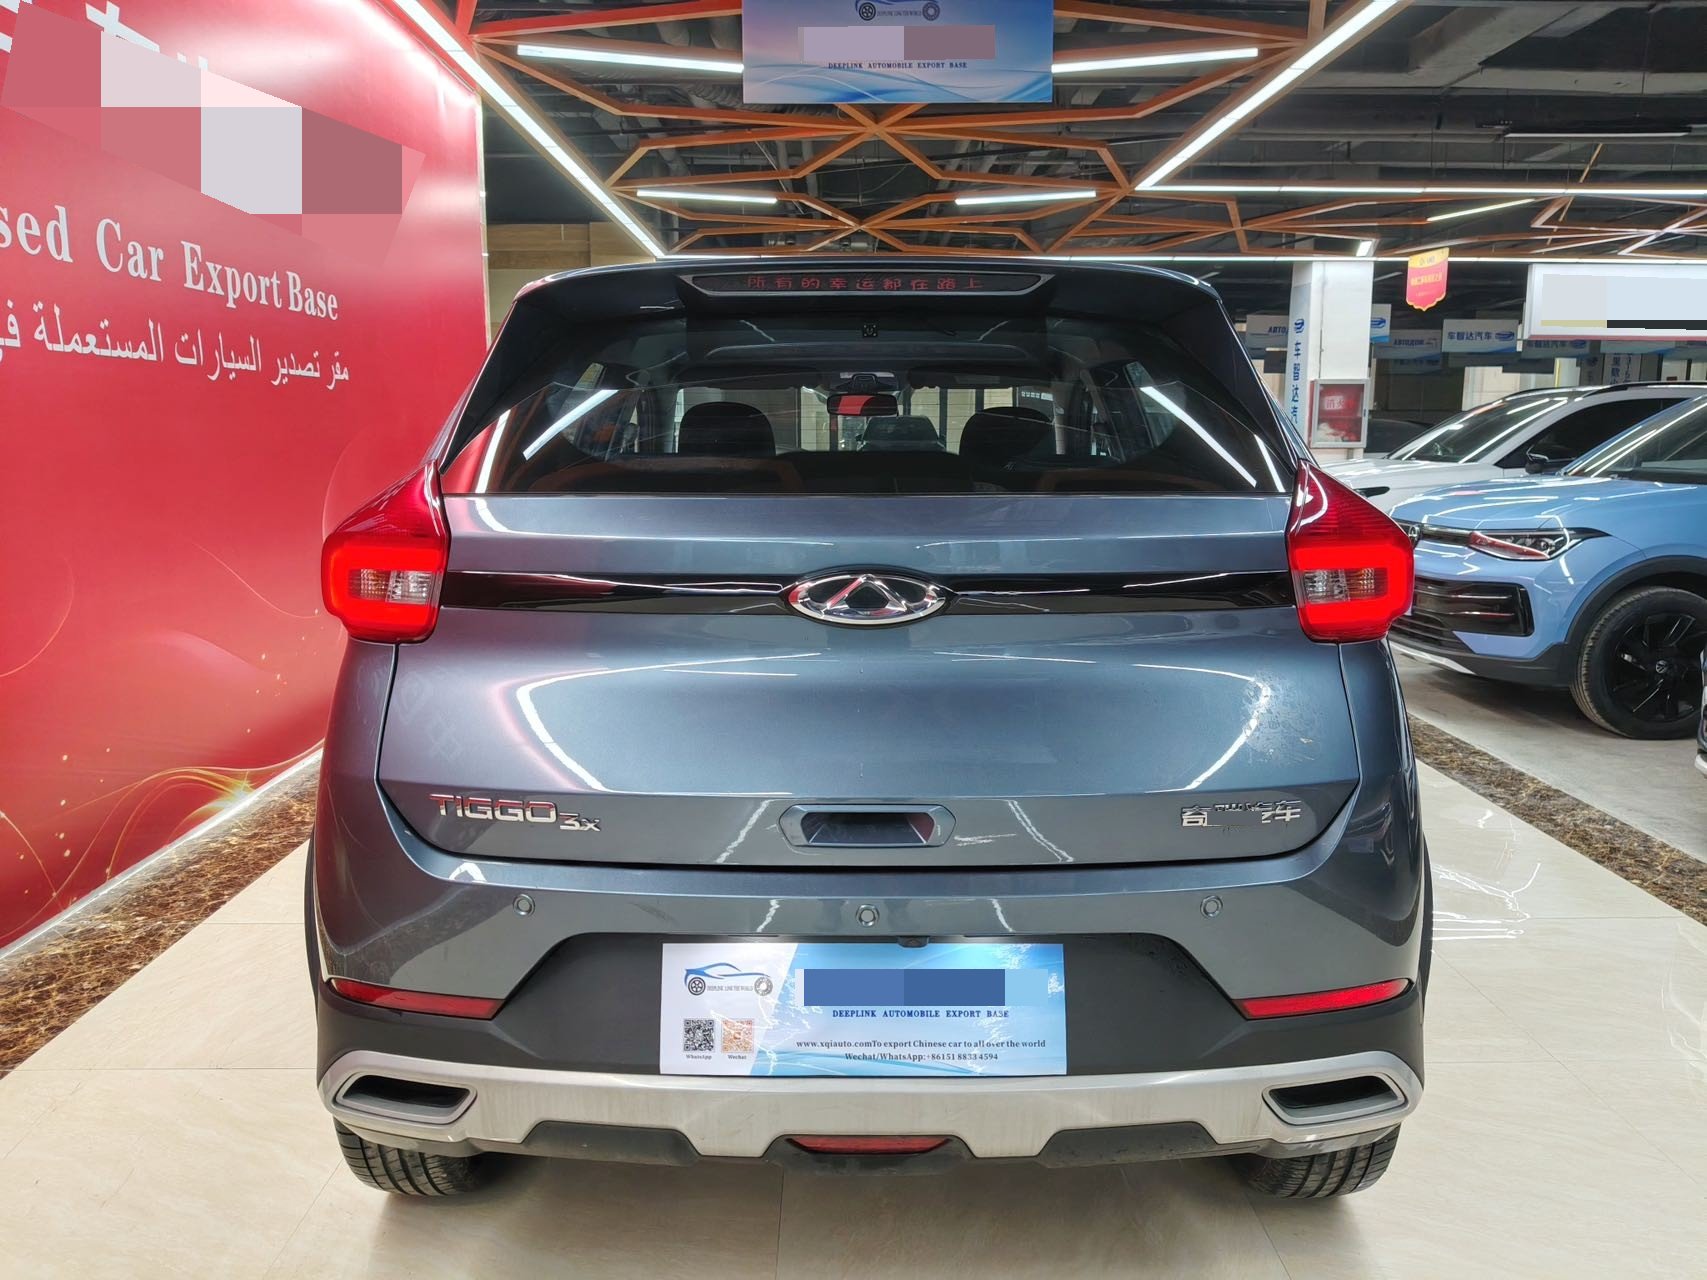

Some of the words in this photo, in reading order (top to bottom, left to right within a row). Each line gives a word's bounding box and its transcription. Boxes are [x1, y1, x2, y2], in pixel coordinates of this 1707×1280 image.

[96, 218, 164, 282] Car
[180, 240, 283, 309] Export
[286, 270, 339, 321] Base
[747, 276, 983, 291] 所有的幸运都在路上
[33, 300, 164, 362] المستعملة
[1447, 331, 1493, 341] 车智达汽车
[174, 328, 262, 381] السيارات
[271, 350, 321, 386] تصدير
[326, 351, 350, 390] مقر
[429, 793, 558, 823] TIGGO
[832, 1009, 877, 1018] DEEPLINK
[882, 1009, 941, 1018] AUTOMOBILE
[946, 1009, 982, 1018] EXPORT
[986, 1009, 1010, 1018] BASE
[883, 1041, 912, 1049] export
[912, 1040, 947, 1048] Chinese
[963, 1040, 972, 1048] to
[973, 1039, 985, 1048] all
[1006, 1039, 1020, 1048] the
[1021, 1039, 1046, 1048] world
[978, 1053, 998, 1061] 4594
